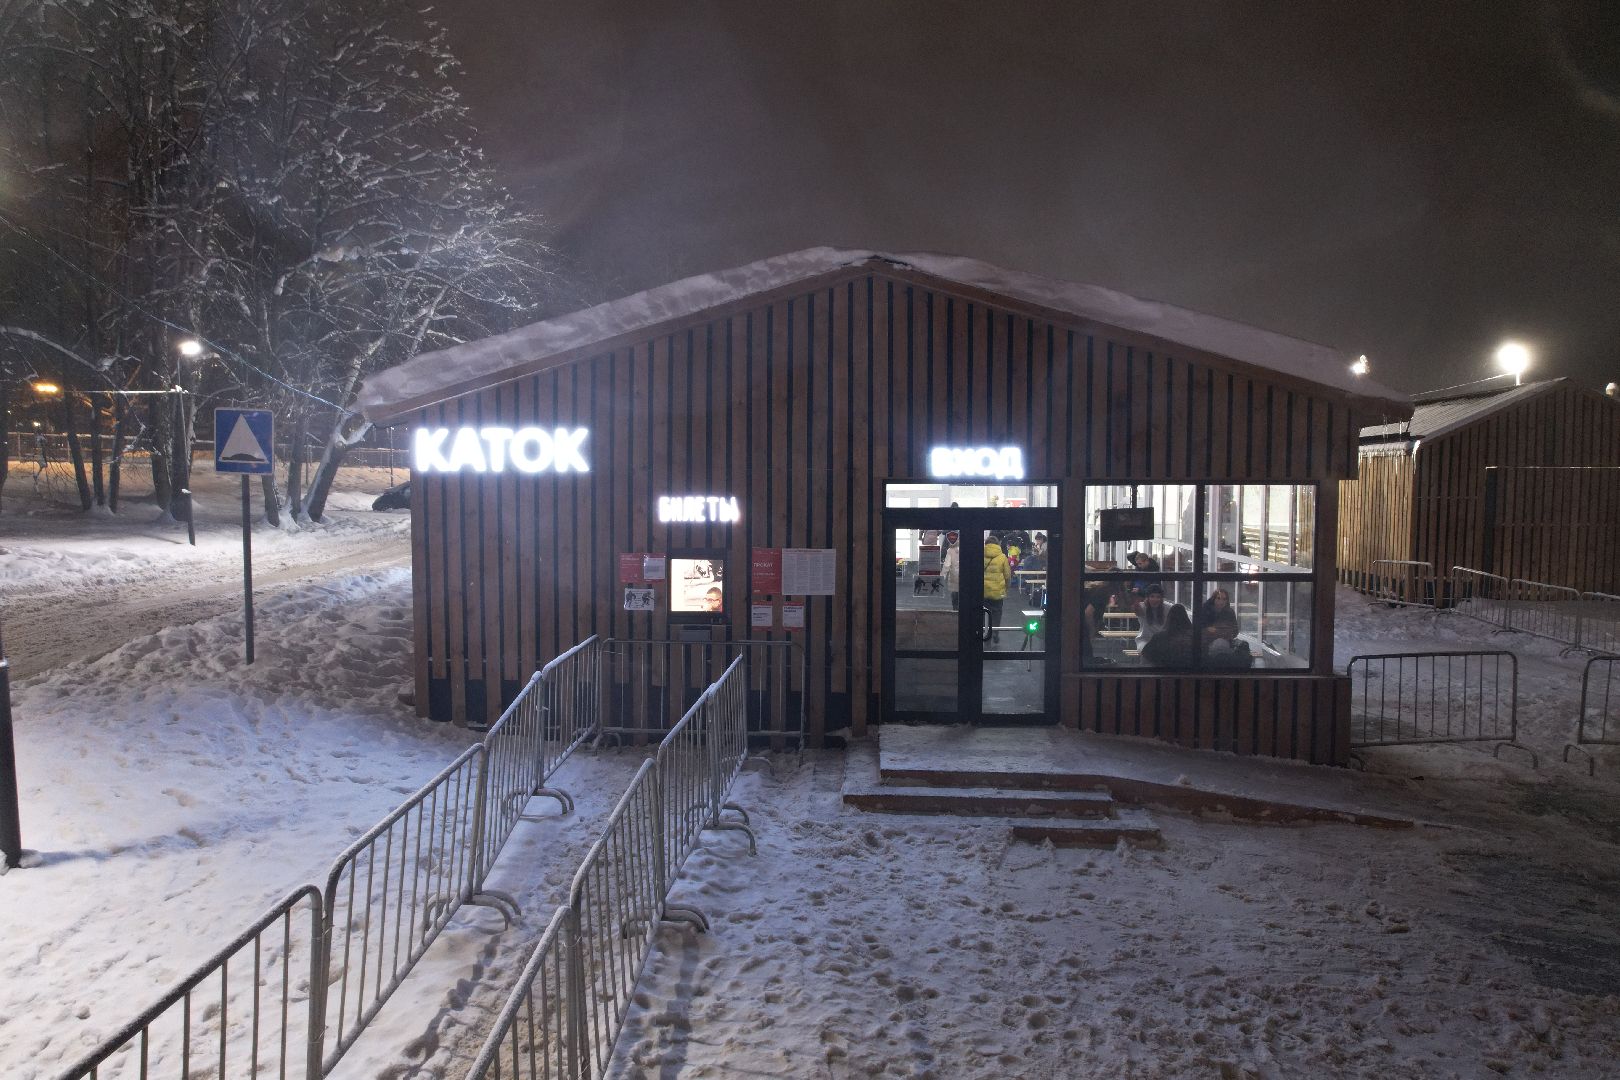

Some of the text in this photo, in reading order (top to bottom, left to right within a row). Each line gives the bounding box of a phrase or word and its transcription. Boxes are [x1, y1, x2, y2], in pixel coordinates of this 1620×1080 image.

[414, 426, 591, 474] КАТОК
[930, 446, 1024, 480] ВХОД
[658, 495, 741, 522] БИЛЕТЫ
